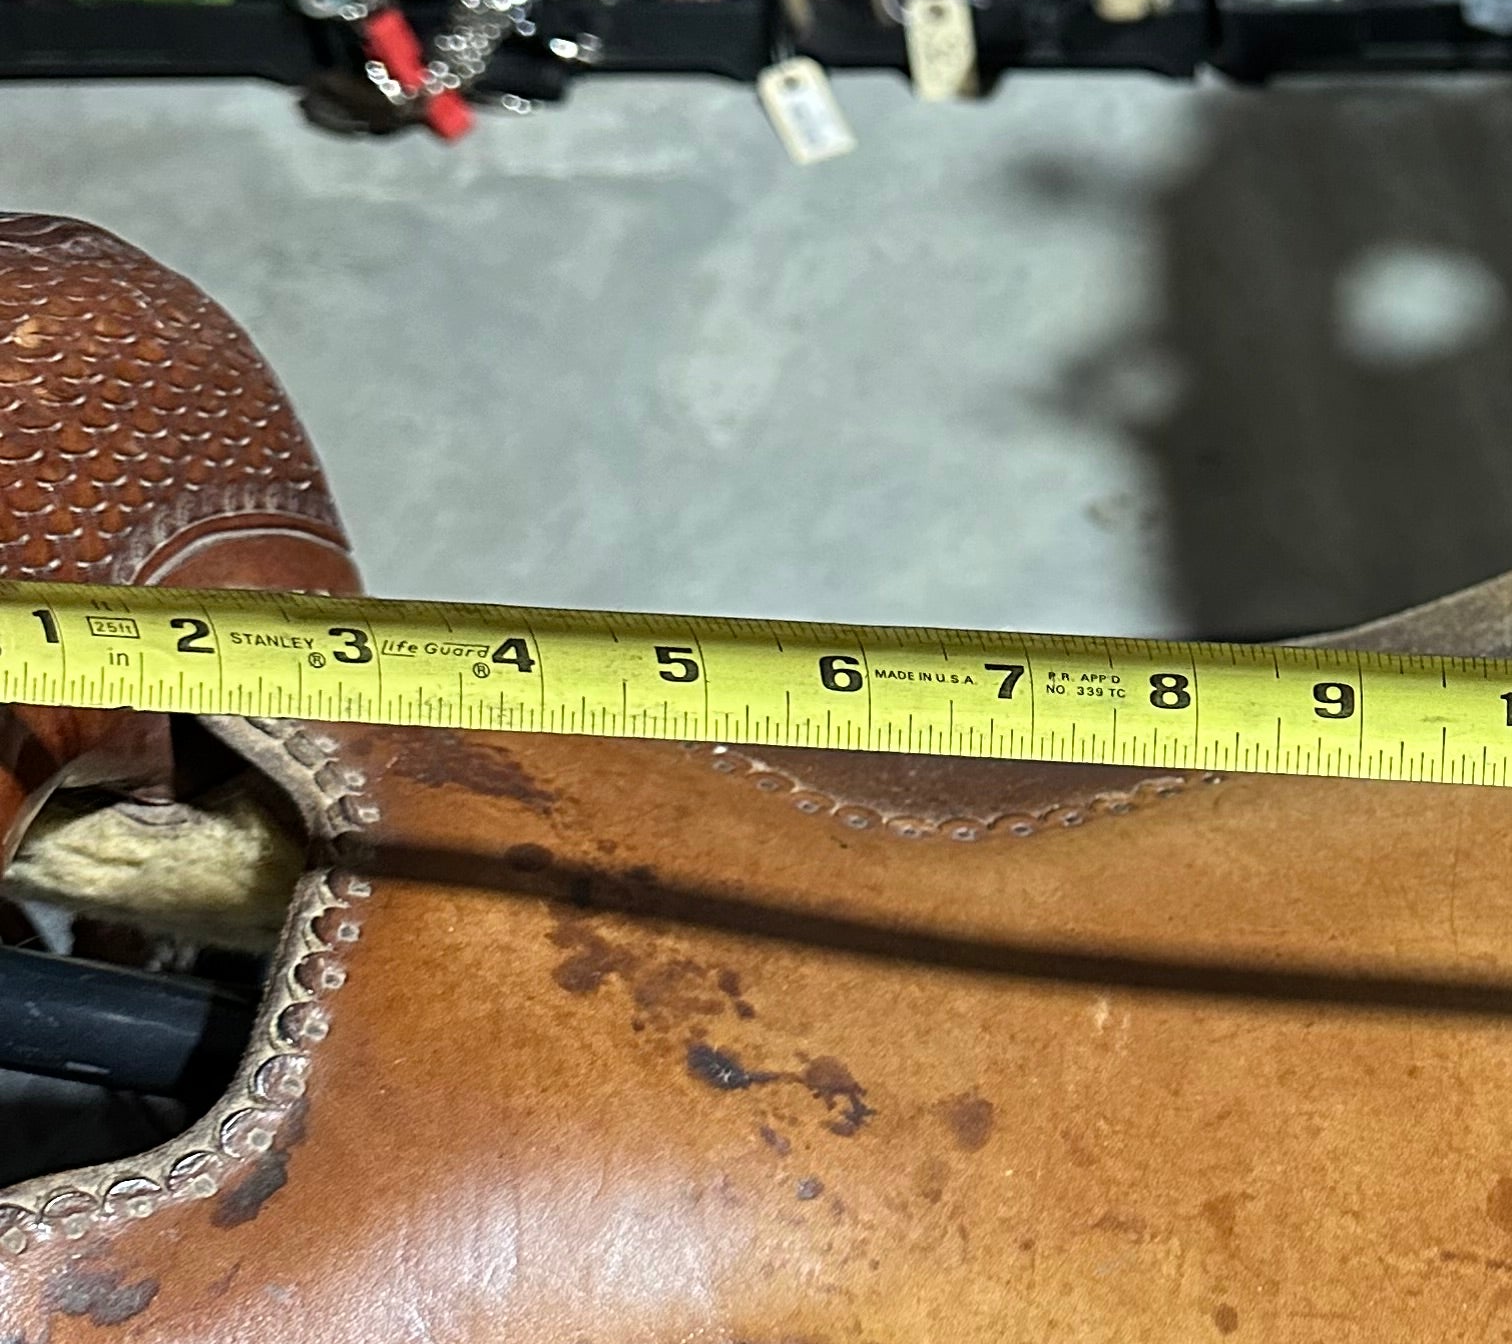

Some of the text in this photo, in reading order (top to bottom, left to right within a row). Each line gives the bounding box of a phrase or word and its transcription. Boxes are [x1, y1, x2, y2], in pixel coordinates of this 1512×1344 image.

[230, 631, 315, 650] STANLEY
[107, 647, 130, 667] in
[424, 641, 490, 659] Guard
[32, 609, 59, 644] 1
[170, 618, 215, 654] 2
[328, 627, 374, 664] 3
[492, 638, 536, 674] 4
[654, 645, 699, 684] 5
[818, 655, 863, 693] 6
[984, 663, 1025, 700] 7
[1149, 672, 1191, 710] 8
[1313, 682, 1355, 719] 9
[875, 669, 915, 681] MADE
[919, 672, 932, 682] IN
[1076, 686, 1104, 697] 339
[1107, 688, 1127, 698] TC
